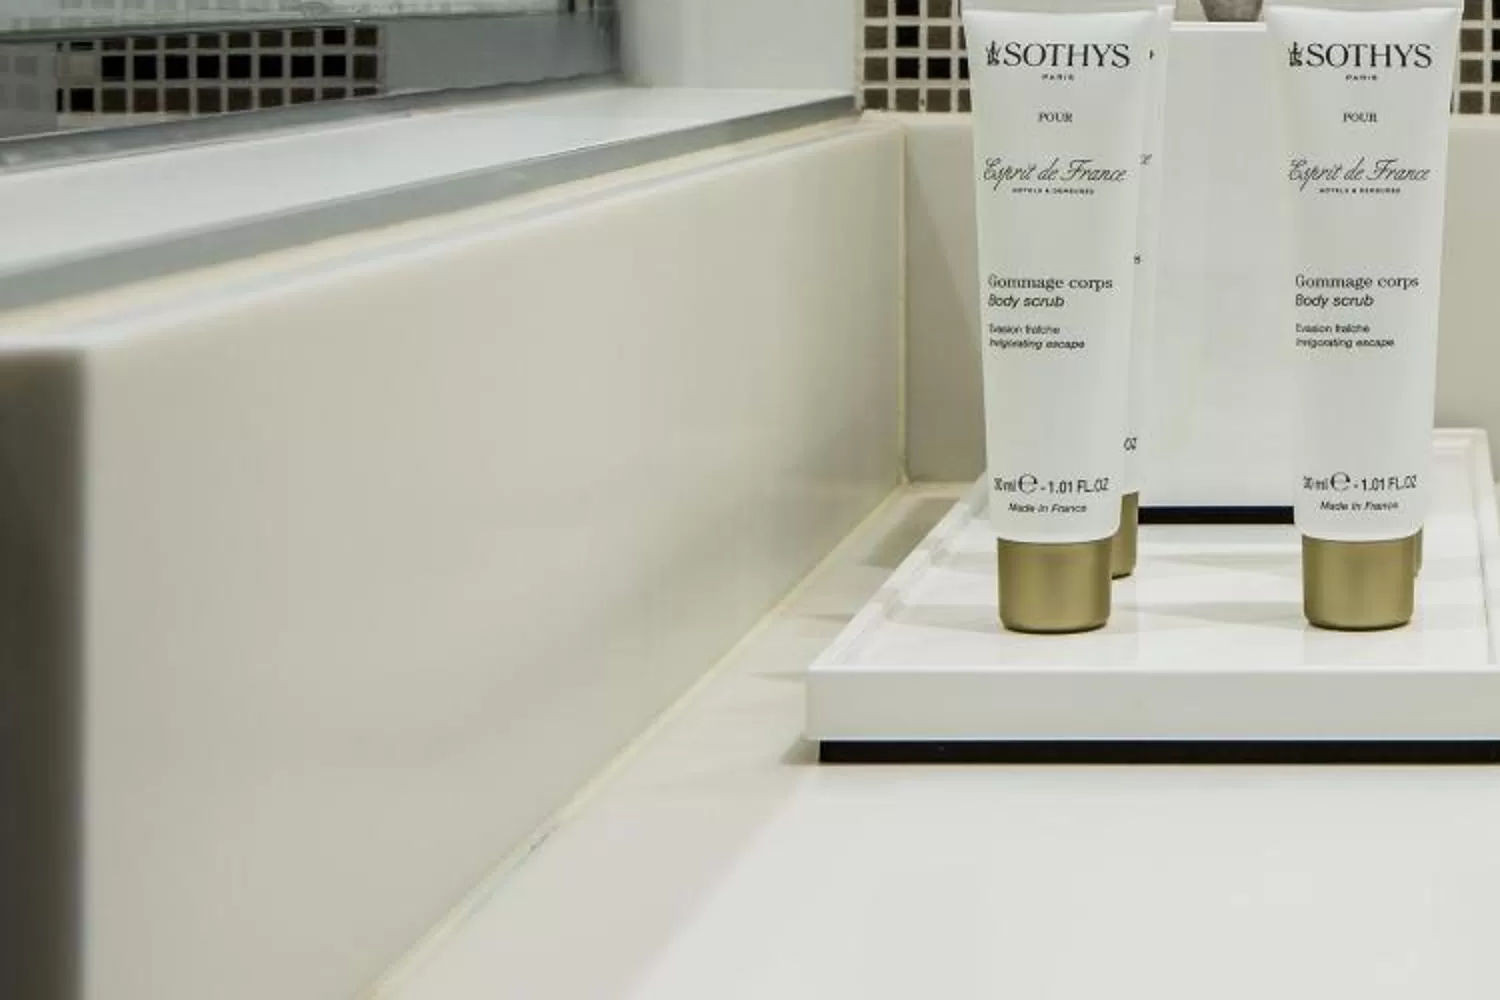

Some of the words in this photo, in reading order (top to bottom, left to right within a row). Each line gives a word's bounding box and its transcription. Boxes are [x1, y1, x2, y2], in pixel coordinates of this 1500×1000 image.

[1003, 42, 1131, 68] SOTHYS
[1306, 42, 1433, 68] SOTHYS
[1038, 112, 1073, 123] POUR
[1342, 112, 1378, 123] POUR
[983, 157, 1036, 191] Esprit
[1037, 157, 1059, 181] de
[1060, 159, 1127, 182] France
[1288, 157, 1342, 192] Esprit
[1343, 156, 1365, 181] de
[1366, 158, 1431, 181] France
[988, 274, 1065, 291] Gommage
[1069, 278, 1113, 290] corps
[1295, 274, 1373, 290] Gommage
[1377, 277, 1419, 290] corps
[988, 294, 1020, 309] Body
[1023, 295, 1065, 307] scrub
[1295, 294, 1328, 309] Body
[1333, 294, 1374, 306] scrub
[1048, 481, 1073, 494] 1.01
[1361, 478, 1385, 491] 1.01
[1008, 503, 1035, 512] Made
[1051, 503, 1087, 512] France
[1319, 500, 1349, 511] Made
[1364, 500, 1399, 511] France
